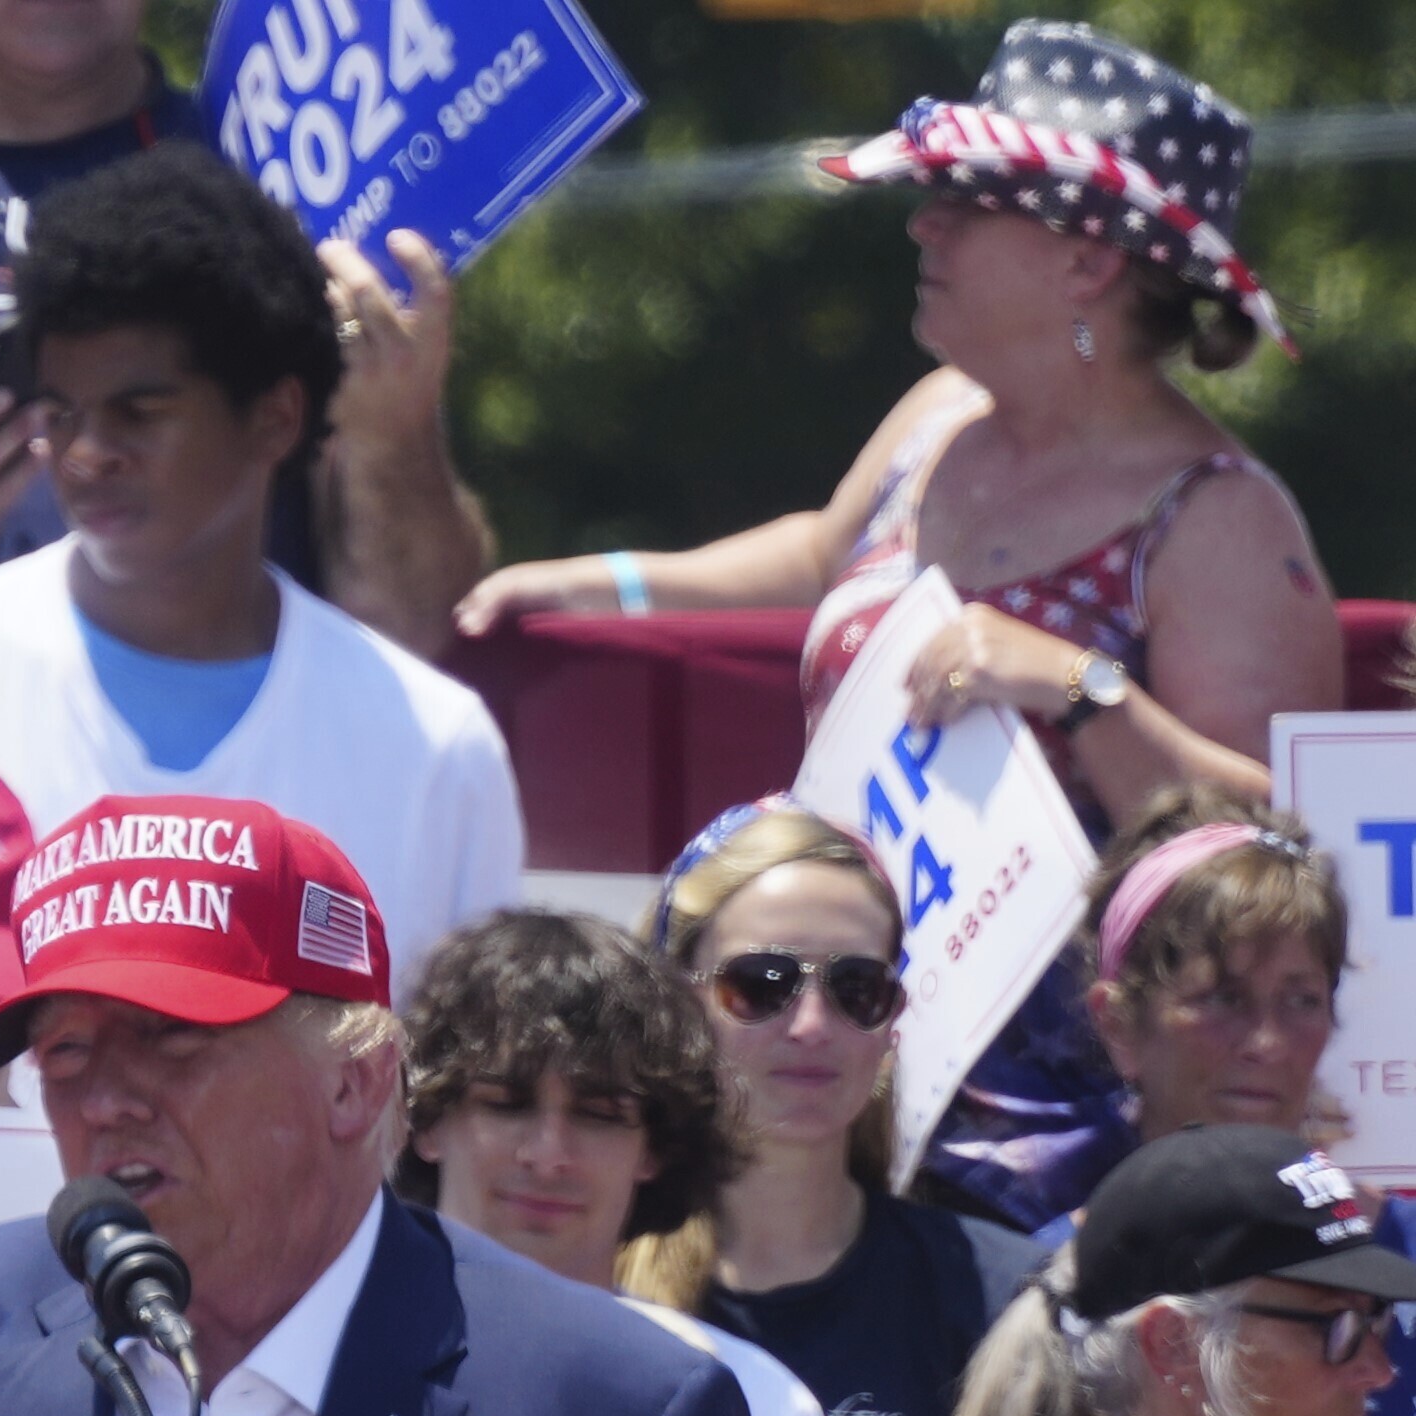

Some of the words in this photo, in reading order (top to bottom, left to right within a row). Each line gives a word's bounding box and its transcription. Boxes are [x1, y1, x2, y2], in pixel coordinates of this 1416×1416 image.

[389, 132, 442, 187] TO
[436, 29, 547, 141] 88022
[12, 831, 79, 914] MAKE
[74, 813, 262, 872] AMERICA
[945, 844, 1036, 963] 88022
[21, 883, 103, 967] GREAT
[101, 876, 234, 935] AGAIN
[1350, 1059, 1416, 1096] TE
